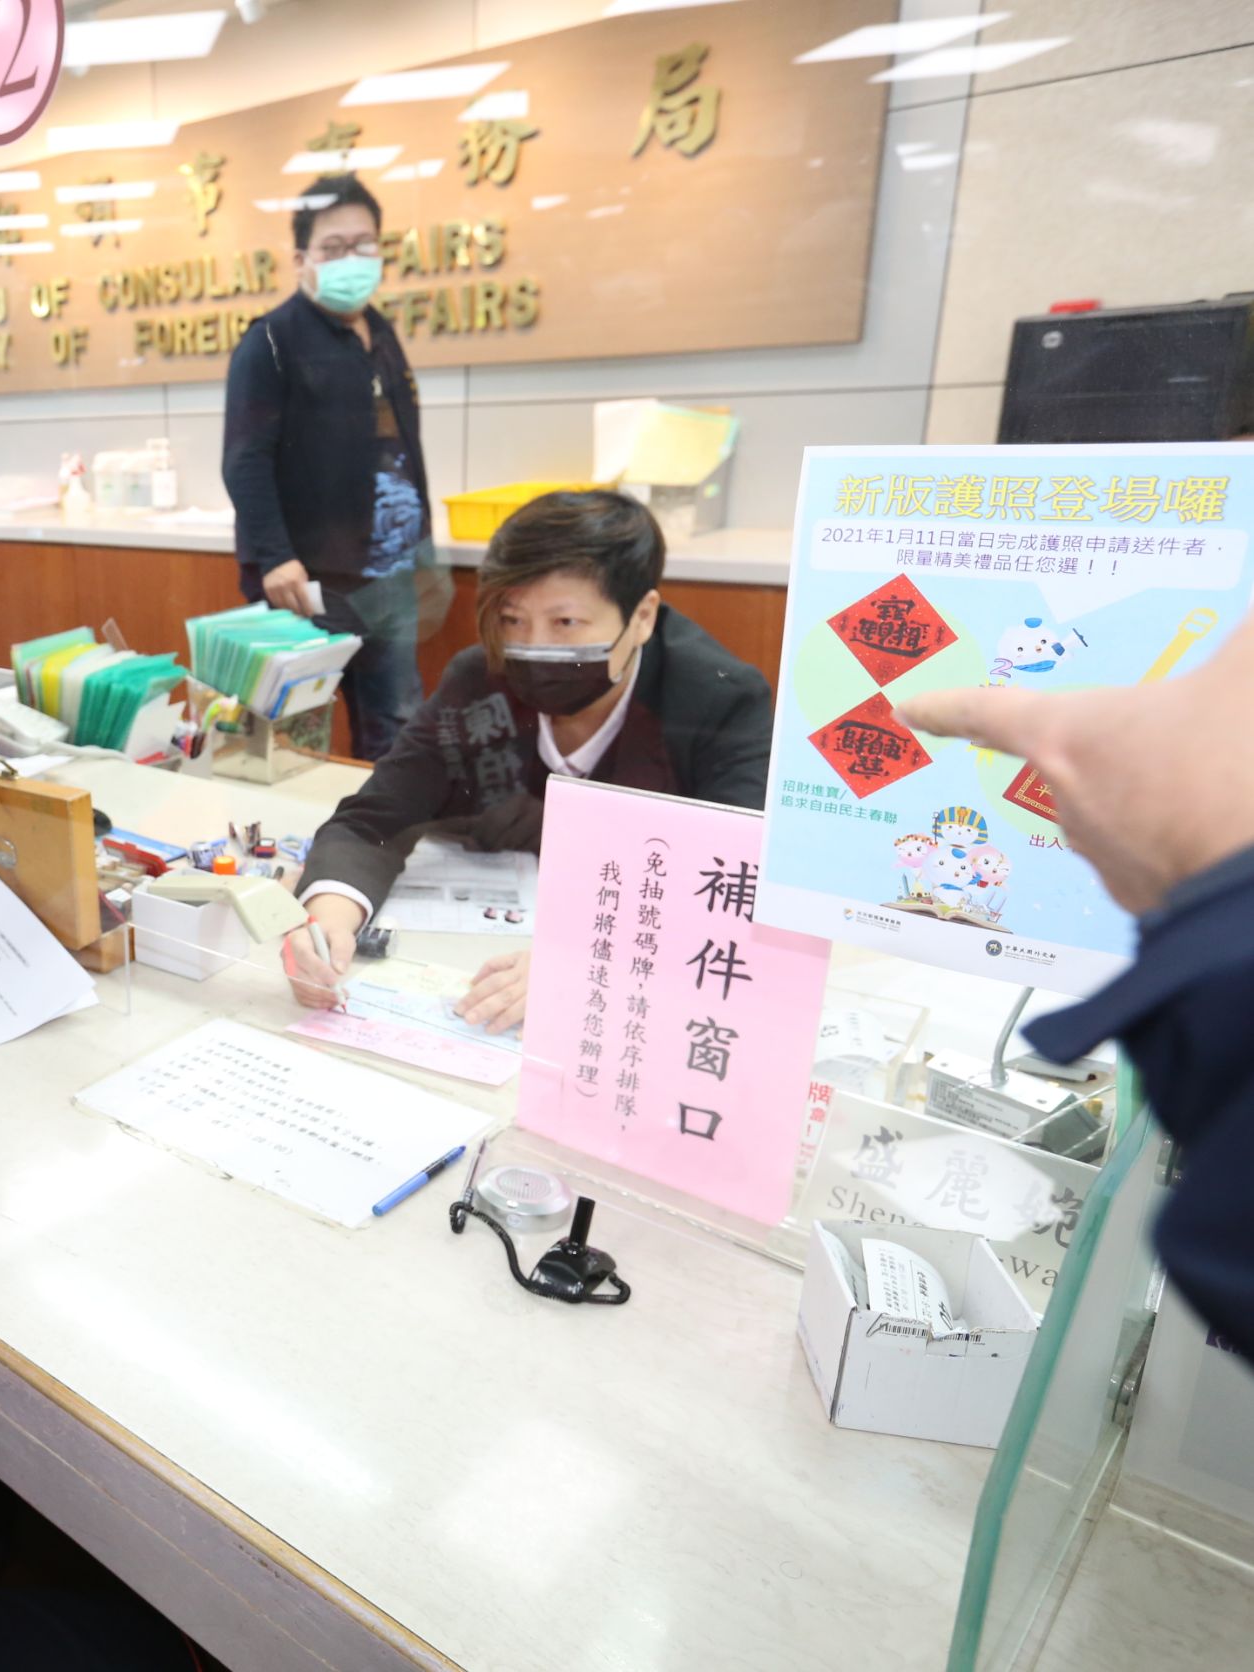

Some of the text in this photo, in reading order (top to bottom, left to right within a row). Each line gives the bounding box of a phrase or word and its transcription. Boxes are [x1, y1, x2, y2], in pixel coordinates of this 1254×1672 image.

[30, 277, 70, 320] OF
[99, 250, 279, 313] CONSULAR
[378, 216, 508, 278] FAIRS
[52, 326, 89, 367] OF
[377, 276, 540, 340] FFAIRS
[834, 473, 1232, 524] 新版護照登場囉
[781, 794, 899, 825] 追求自由民主春聯
[1029, 833, 1074, 853] 出入
[677, 855, 760, 1142] 補件窗口
[826, 1184, 927, 1228] Shen
